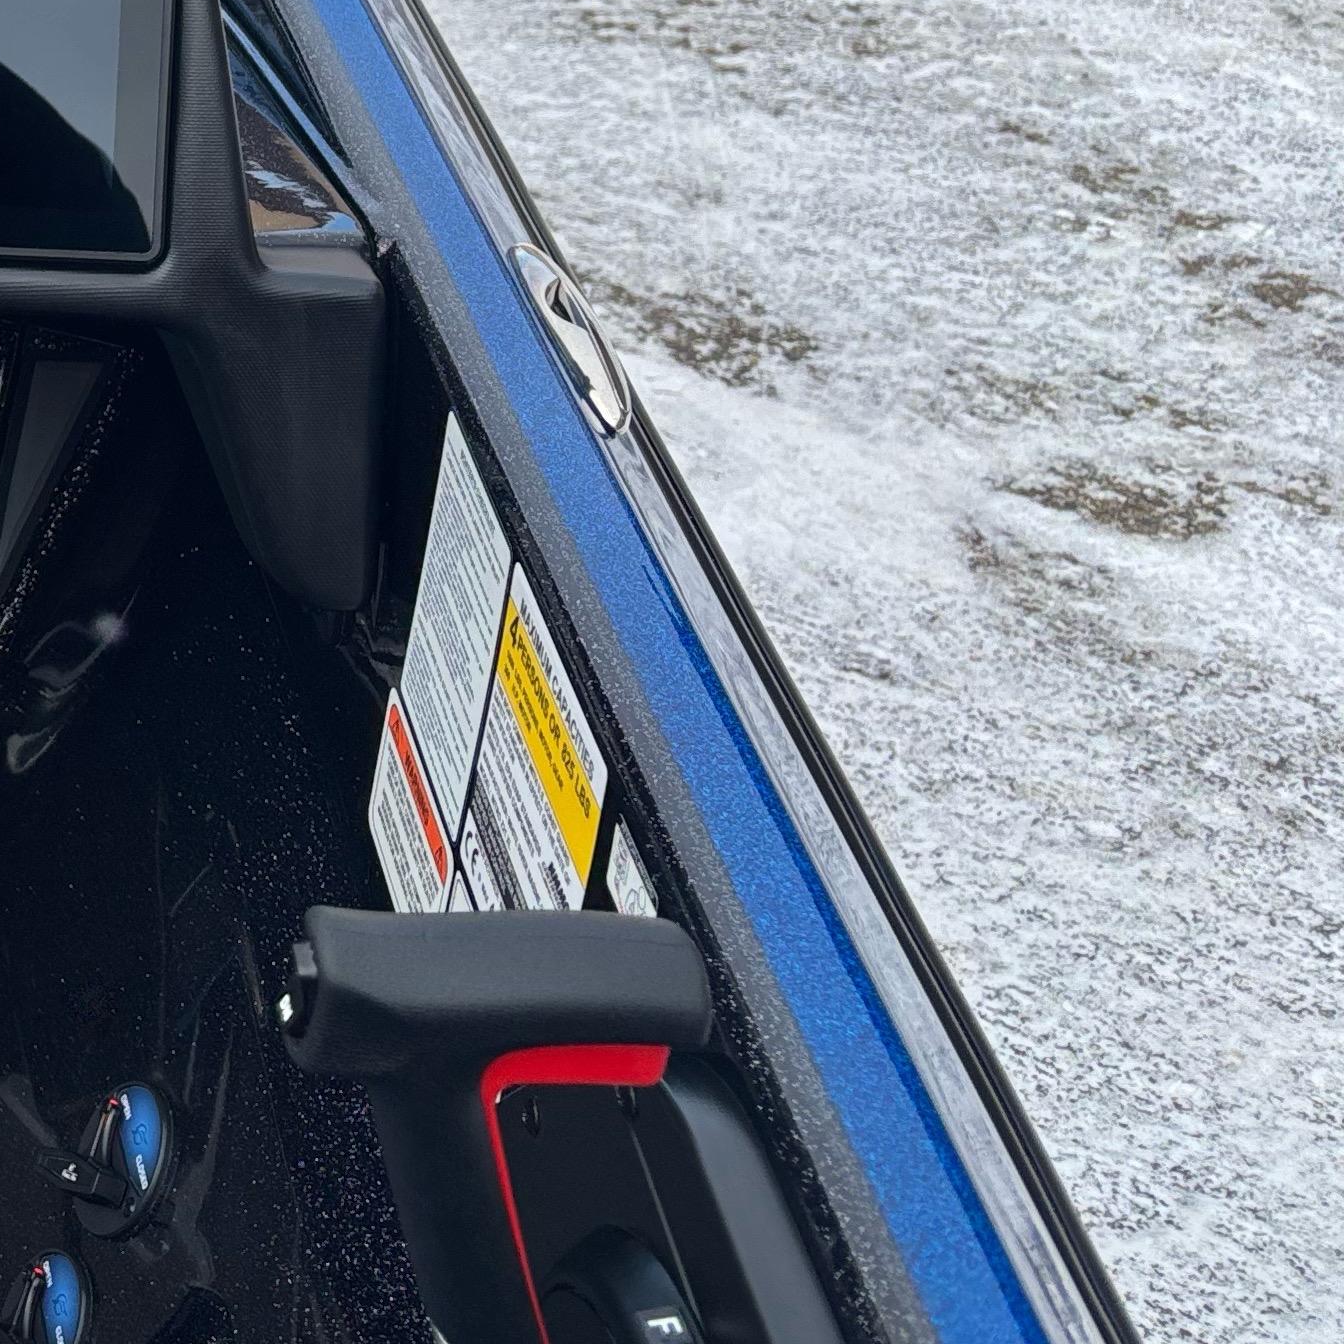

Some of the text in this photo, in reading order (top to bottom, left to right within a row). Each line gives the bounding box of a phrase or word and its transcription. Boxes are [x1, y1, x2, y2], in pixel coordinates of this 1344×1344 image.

[509, 614, 520, 650] 4
[516, 633, 550, 719] PERSONS
[548, 711, 561, 748] OR
[519, 596, 553, 681] MAXIMUM
[551, 674, 595, 782] CAPACITIES
[646, 1316, 683, 1334] F
